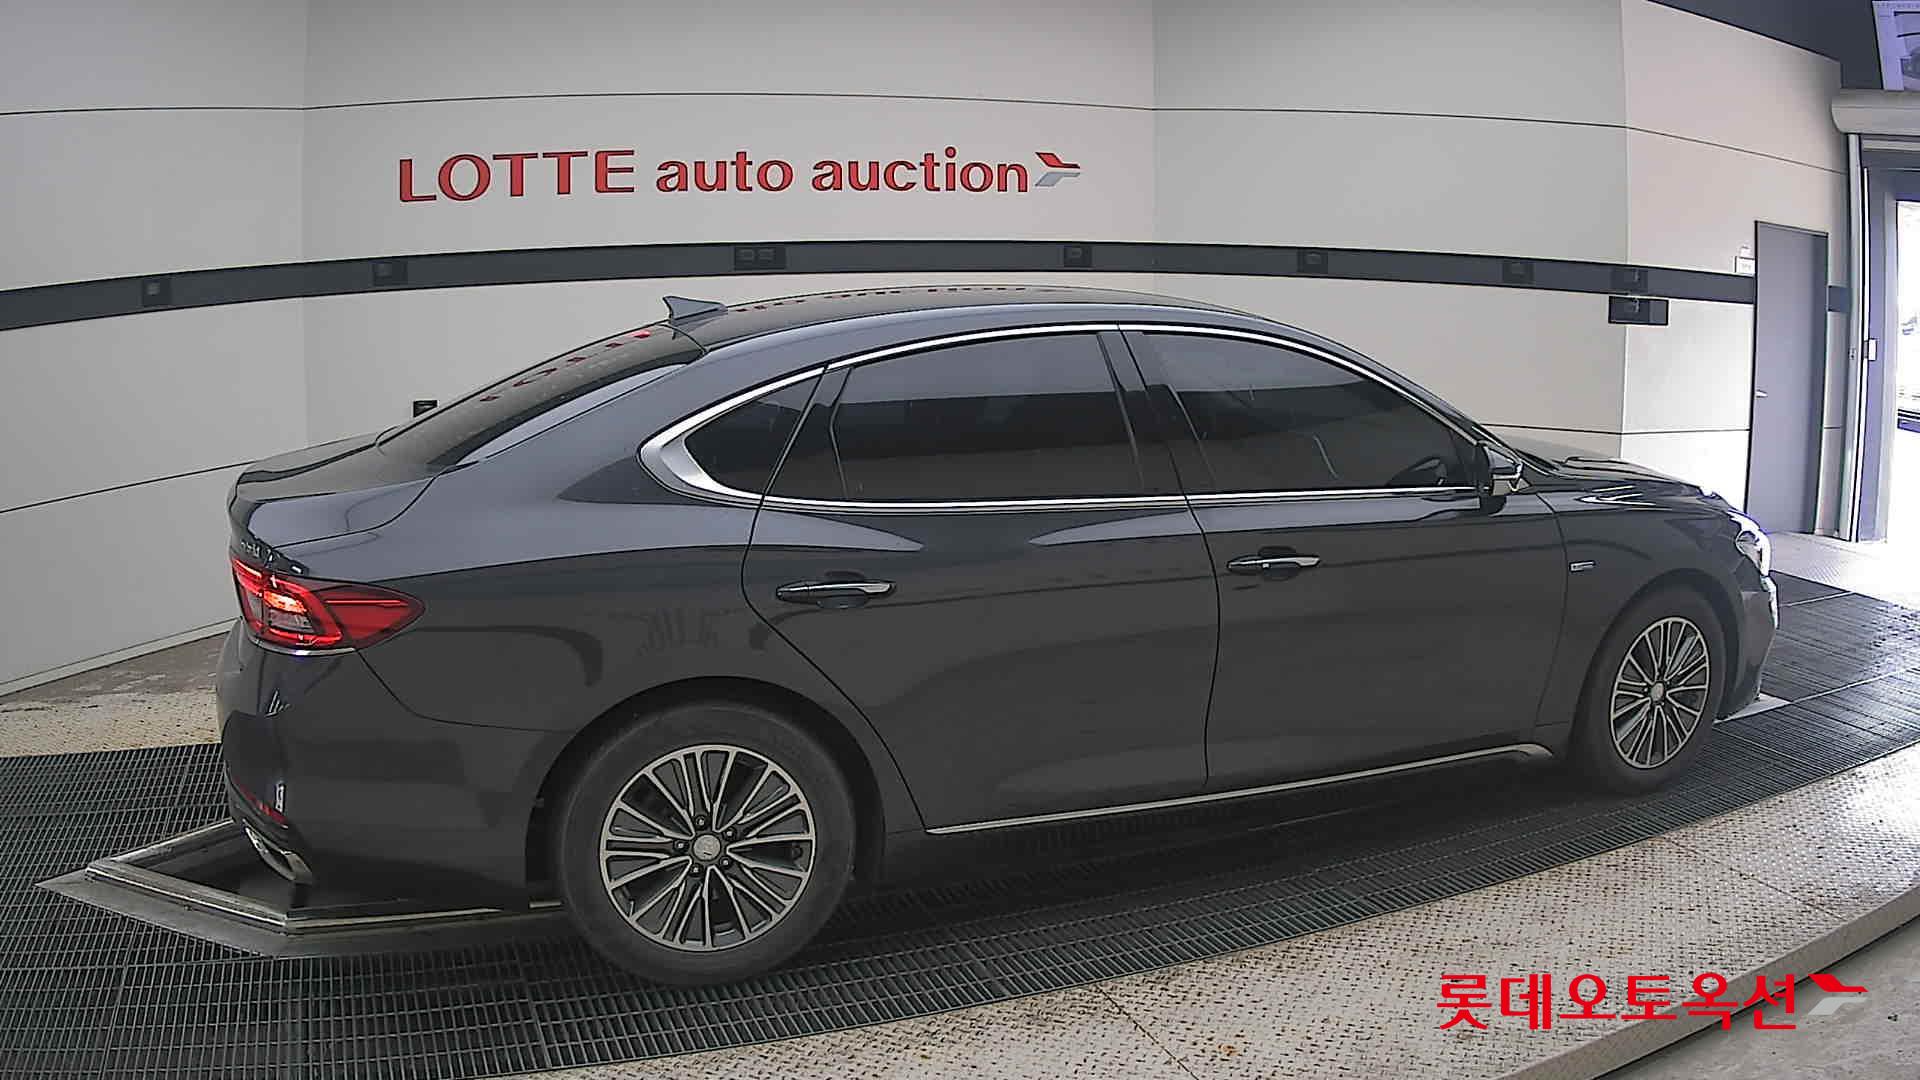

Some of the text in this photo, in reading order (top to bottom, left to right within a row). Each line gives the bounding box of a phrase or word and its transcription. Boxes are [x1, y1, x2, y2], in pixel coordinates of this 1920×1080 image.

[399, 146, 1030, 202] LOTTE auto auction
